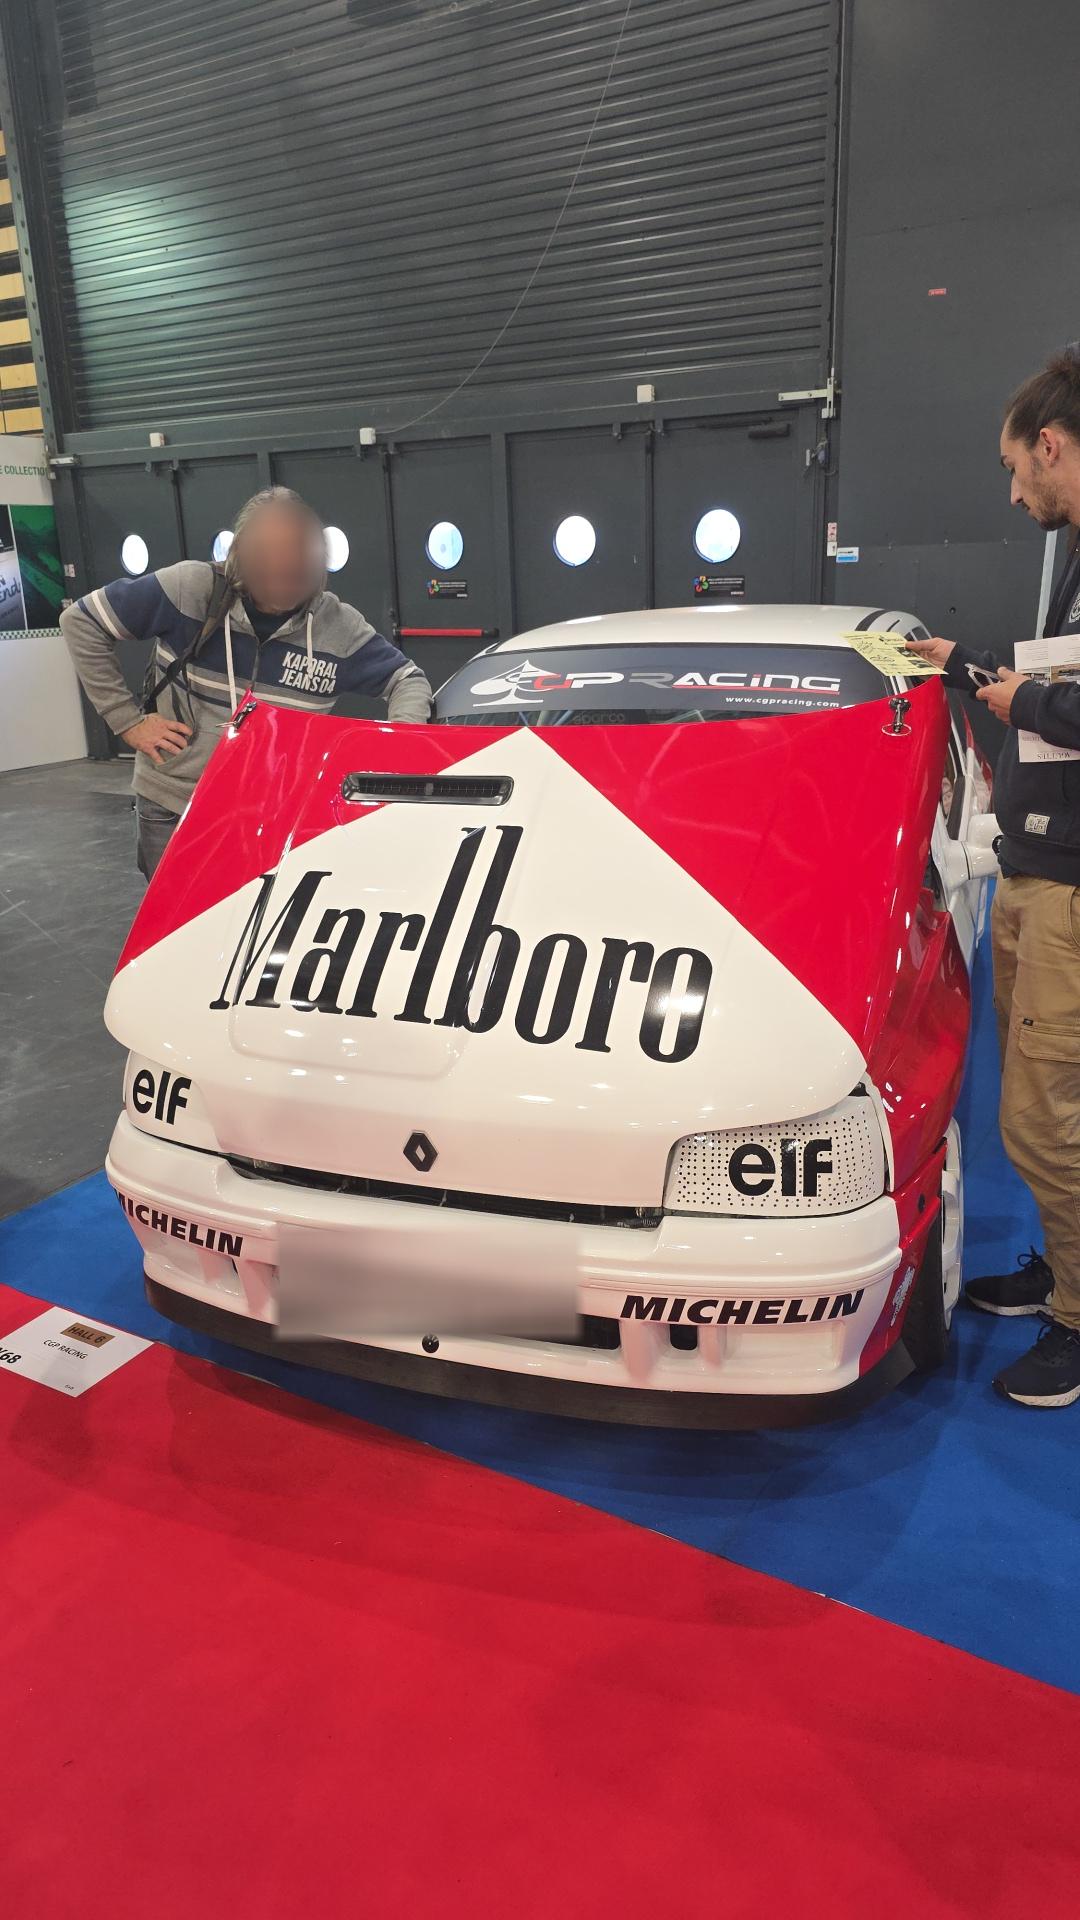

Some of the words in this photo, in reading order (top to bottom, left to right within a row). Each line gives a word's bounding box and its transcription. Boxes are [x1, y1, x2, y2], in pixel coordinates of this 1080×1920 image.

[282, 651, 338, 679] KAPORAL
[725, 697, 840, 707] www.cgpracing.com
[209, 825, 713, 1064] Marlboro
[132, 1069, 192, 1125] elf
[728, 1137, 833, 1198] elf
[619, 1289, 865, 1326] MICHELIN
[43, 1339, 61, 1350] CGP
[58, 1345, 89, 1360] RACING
[68, 1326, 96, 1341] HALL
